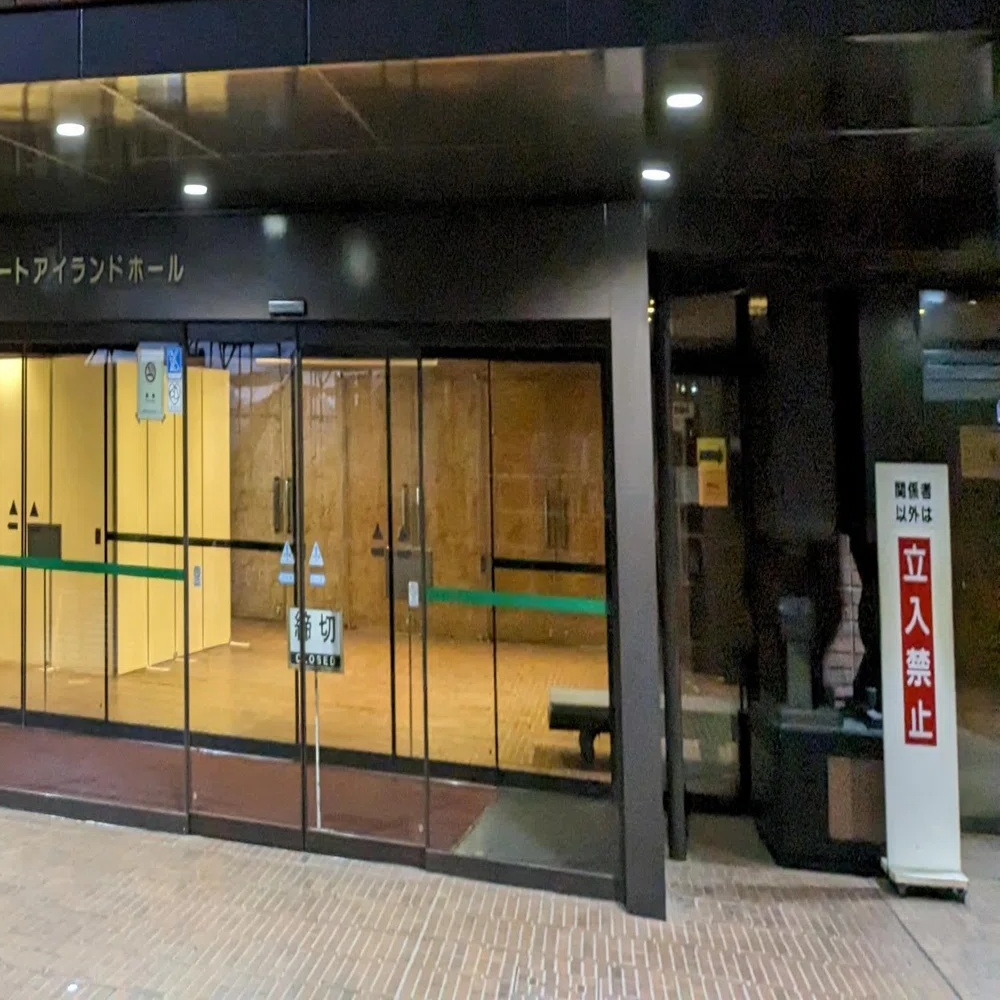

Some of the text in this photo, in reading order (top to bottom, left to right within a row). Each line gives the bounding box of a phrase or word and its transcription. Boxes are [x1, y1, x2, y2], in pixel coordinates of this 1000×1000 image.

[894, 481, 931, 499] 関係者
[896, 504, 932, 522] 以外は
[902, 544, 934, 740] 立入禁止
